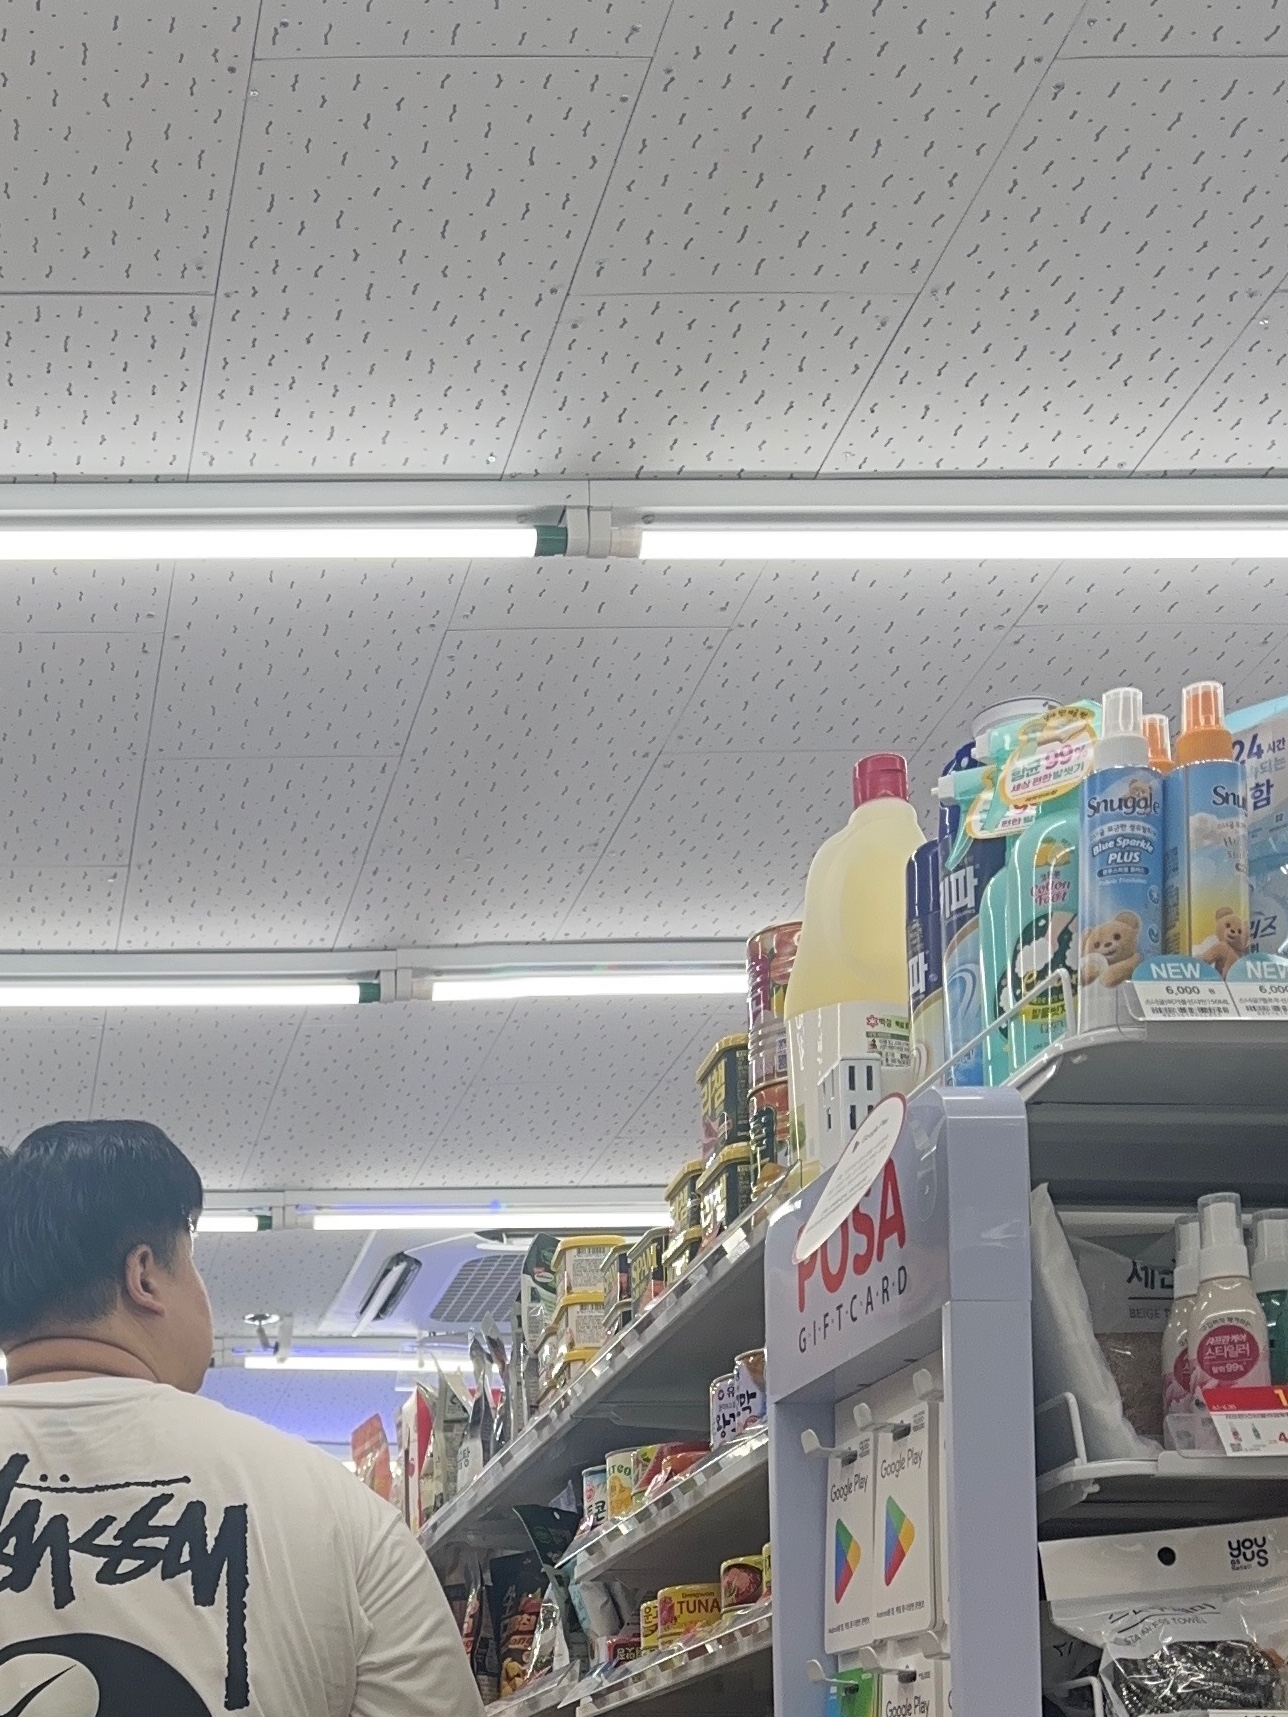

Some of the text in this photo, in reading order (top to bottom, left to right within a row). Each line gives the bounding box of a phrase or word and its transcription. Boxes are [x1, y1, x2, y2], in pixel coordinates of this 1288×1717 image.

[1232, 733, 1265, 765] 24
[1087, 785, 1160, 818] Snuggle
[1092, 836, 1154, 856] Blue Sparkle
[1107, 851, 1141, 865] PLUS
[1150, 962, 1200, 980] NEW
[1165, 985, 1201, 996] 6,000
[1129, 1306, 1160, 1319] BEIGE
[1203, 1343, 1251, 1360] 스타일러
[880, 1448, 924, 1479] Google Play
[830, 1473, 869, 1503] Google Play
[1228, 1536, 1267, 1558] you
[676, 1598, 722, 1616] TUNA
[1171, 1616, 1208, 1625] TOWEL
